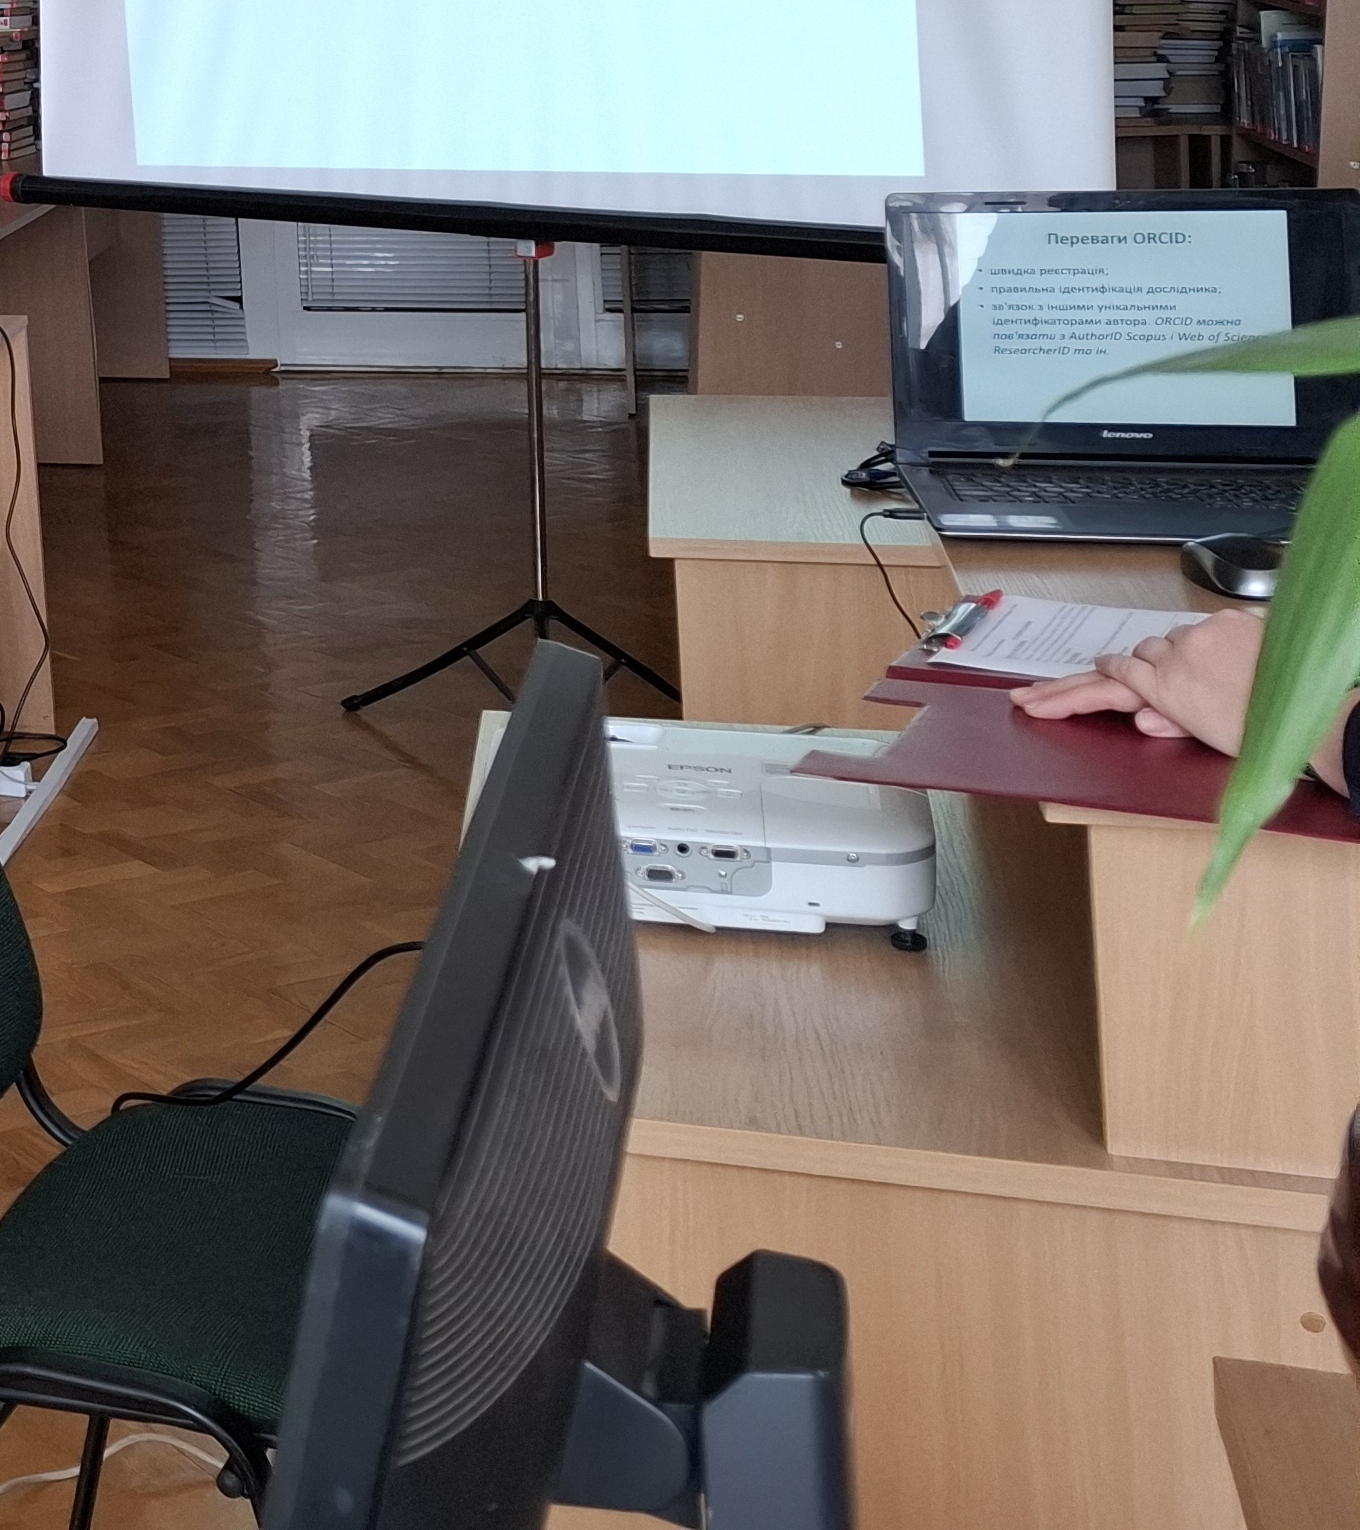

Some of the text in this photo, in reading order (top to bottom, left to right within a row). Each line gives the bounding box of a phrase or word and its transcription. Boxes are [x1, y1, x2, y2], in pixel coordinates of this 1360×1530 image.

[1047, 232, 1192, 247] Переваги ORCID:
[990, 268, 1036, 276] швидка
[991, 286, 1055, 295] правильна
[1059, 284, 1142, 294] ідентифікація
[992, 302, 1034, 310] зв'язок
[1097, 304, 1177, 312] унікальними
[993, 317, 1101, 327] ідентифікаторами
[1105, 319, 1151, 327] автора.
[1155, 317, 1193, 326] ORCID
[993, 332, 1056, 340] пов'язати
[1069, 332, 1123, 341] AuthorID
[1125, 332, 1166, 342] Scopus
[1178, 332, 1204, 341] Web
[1208, 332, 1221, 343] of
[993, 346, 1070, 355] ResearcherID
[1102, 430, 1153, 438] lenovo
[668, 764, 732, 773] EPSON
